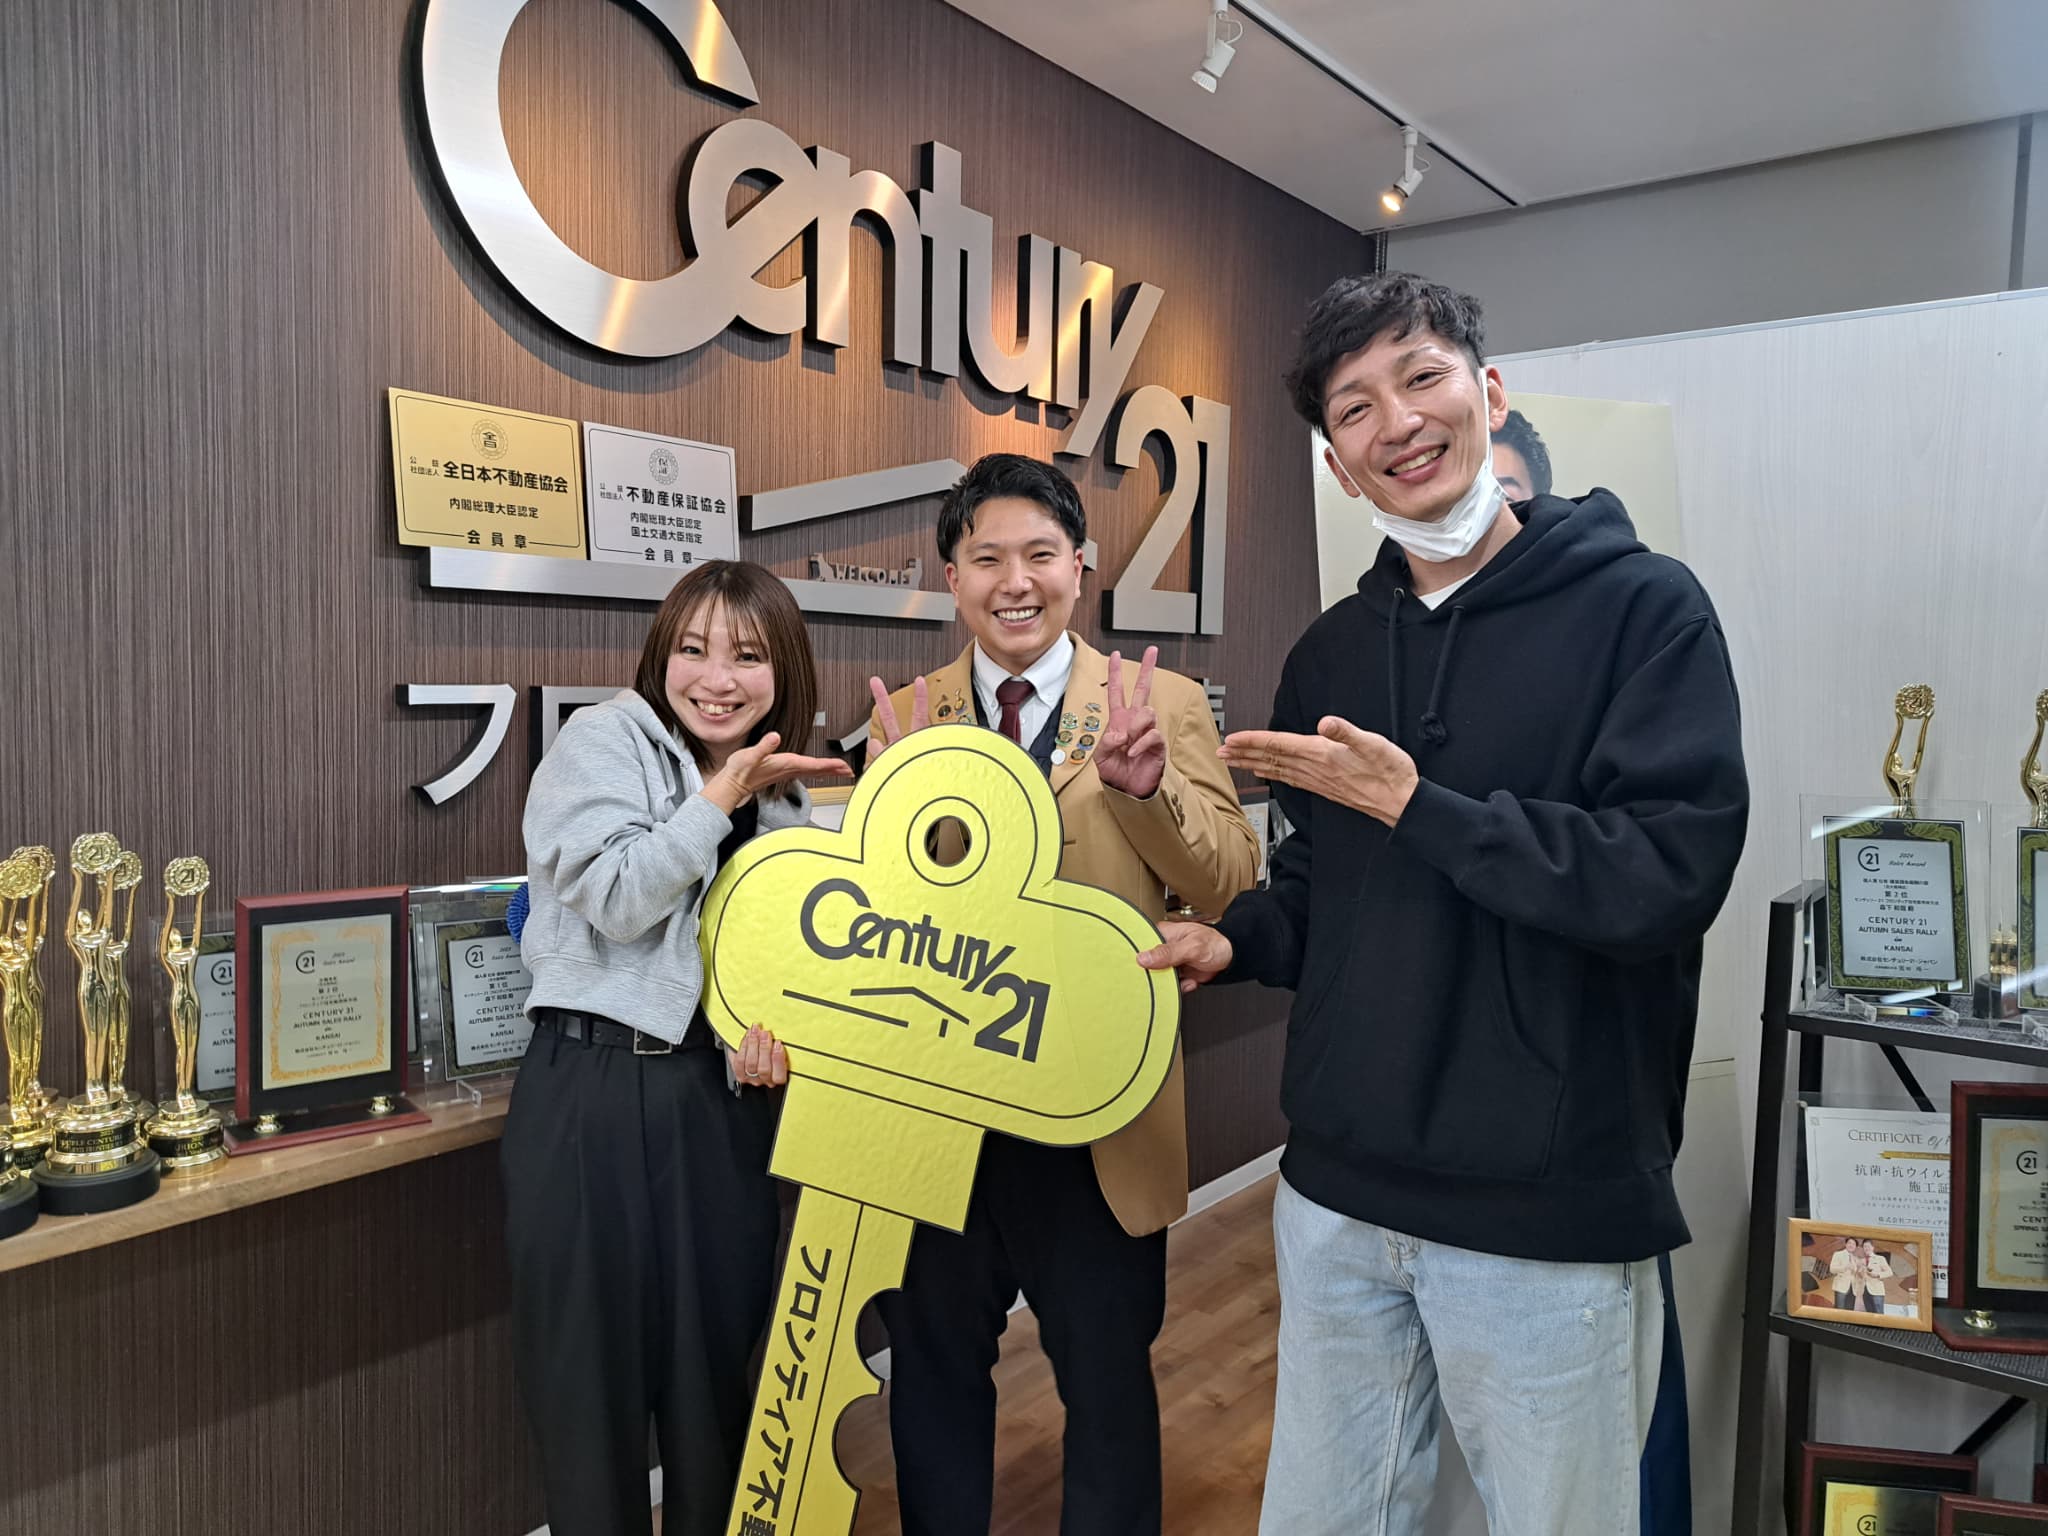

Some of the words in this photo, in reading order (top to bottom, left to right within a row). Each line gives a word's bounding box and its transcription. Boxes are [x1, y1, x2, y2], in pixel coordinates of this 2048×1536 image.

[422, 0, 1164, 458] Century
[1107, 384, 1231, 635] 21
[443, 461, 568, 493] 全日本不動産協会
[450, 497, 539, 518] 内閣総理大臣認定
[626, 486, 726, 514] 不動産保証協会
[630, 512, 702, 530] 内閣総理大臣認定
[467, 529, 527, 549] 会員章
[631, 526, 703, 544] 国土交通大臣指定
[645, 547, 692, 564] 会員章
[834, 564, 913, 585] WELCOME
[1868, 916, 1915, 926] CENTURY
[1918, 918, 1928, 926] 21
[1858, 926, 1889, 934] AUTUMN
[1916, 928, 1938, 936] RALLY
[1884, 945, 1913, 953] KANSAI
[800, 878, 1017, 992] Century
[974, 972, 1051, 1063] 21
[303, 1009, 343, 1020] CENTURY
[476, 1003, 516, 1015] CENTURY
[468, 1017, 494, 1025] AUTUMN
[316, 1033, 341, 1041] KANSAI
[490, 1029, 514, 1038] KANSAI
[1848, 1129, 1923, 1144] CERTIFICATE
